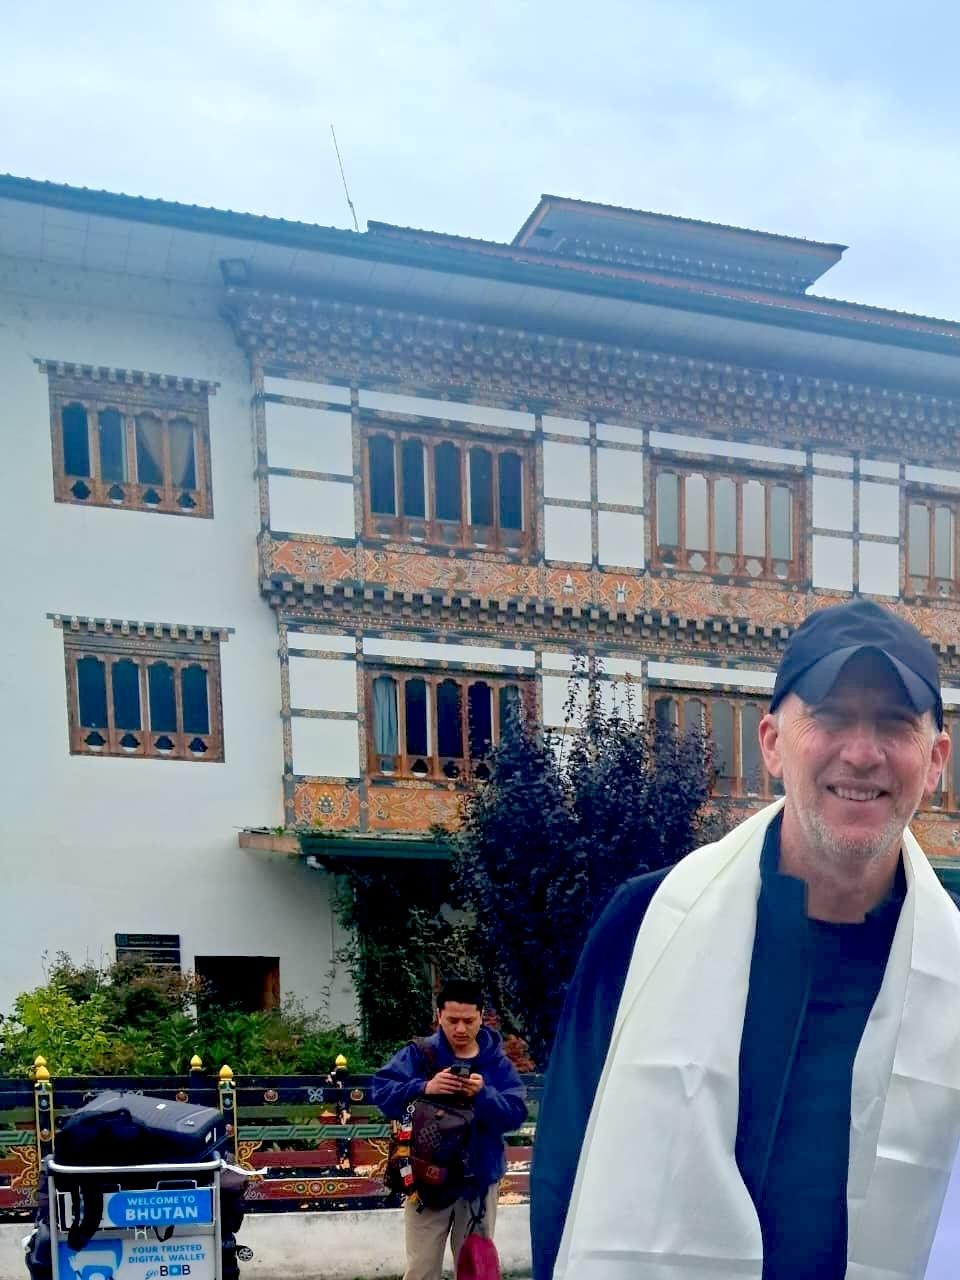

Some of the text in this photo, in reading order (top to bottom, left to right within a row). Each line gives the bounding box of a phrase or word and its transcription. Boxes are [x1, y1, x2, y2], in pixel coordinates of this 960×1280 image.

[127, 1195, 196, 1206] WELCOME TO
[125, 1206, 199, 1221] BHUTAN
[132, 1244, 202, 1255] YOUR TRUSTED
[128, 1253, 206, 1264] DIGITAL WALLET
